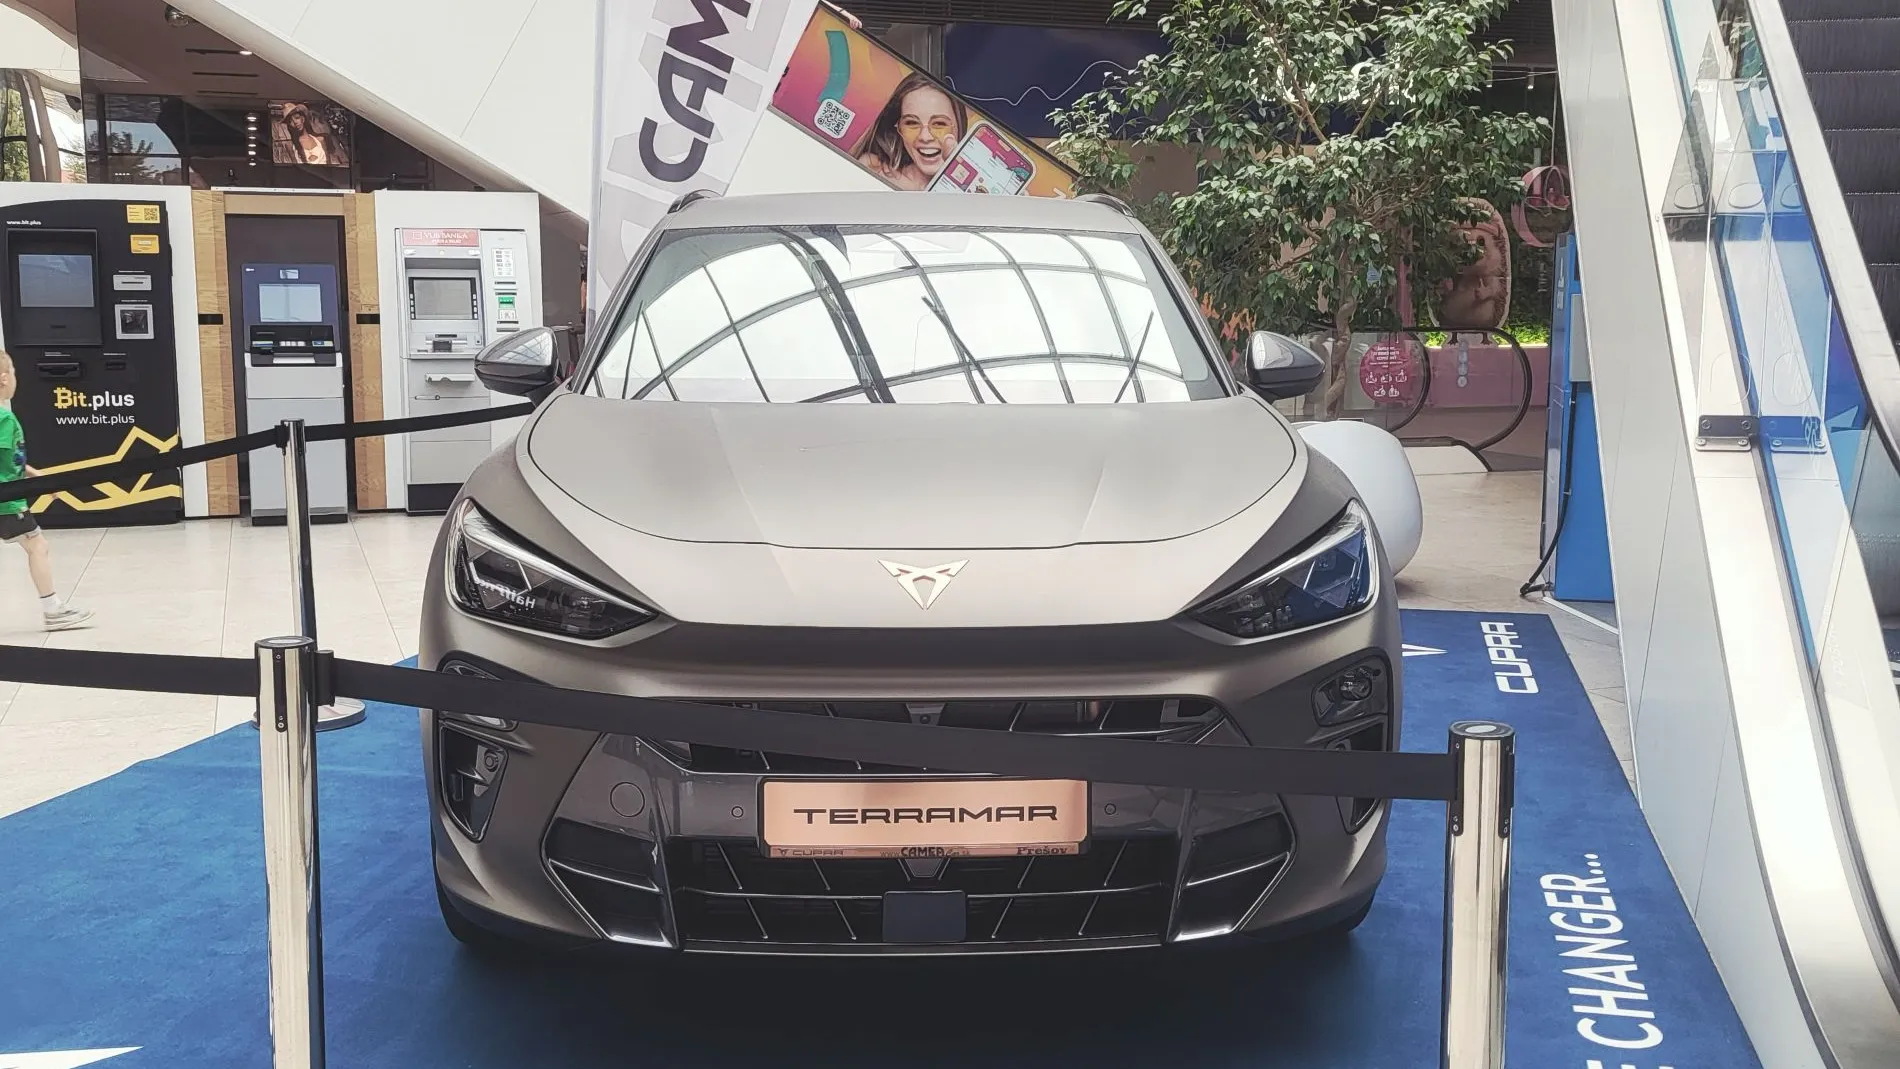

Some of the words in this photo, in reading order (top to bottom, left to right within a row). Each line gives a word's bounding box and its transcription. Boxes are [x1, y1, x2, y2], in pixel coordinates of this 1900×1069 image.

[56, 413, 135, 426] www.bit.plus
[1480, 621, 1539, 694] CUPRA
[793, 806, 1058, 825] TERRAMAR
[1016, 845, 1068, 856] Prešov
[1540, 853, 1664, 1049] CHANGER...
